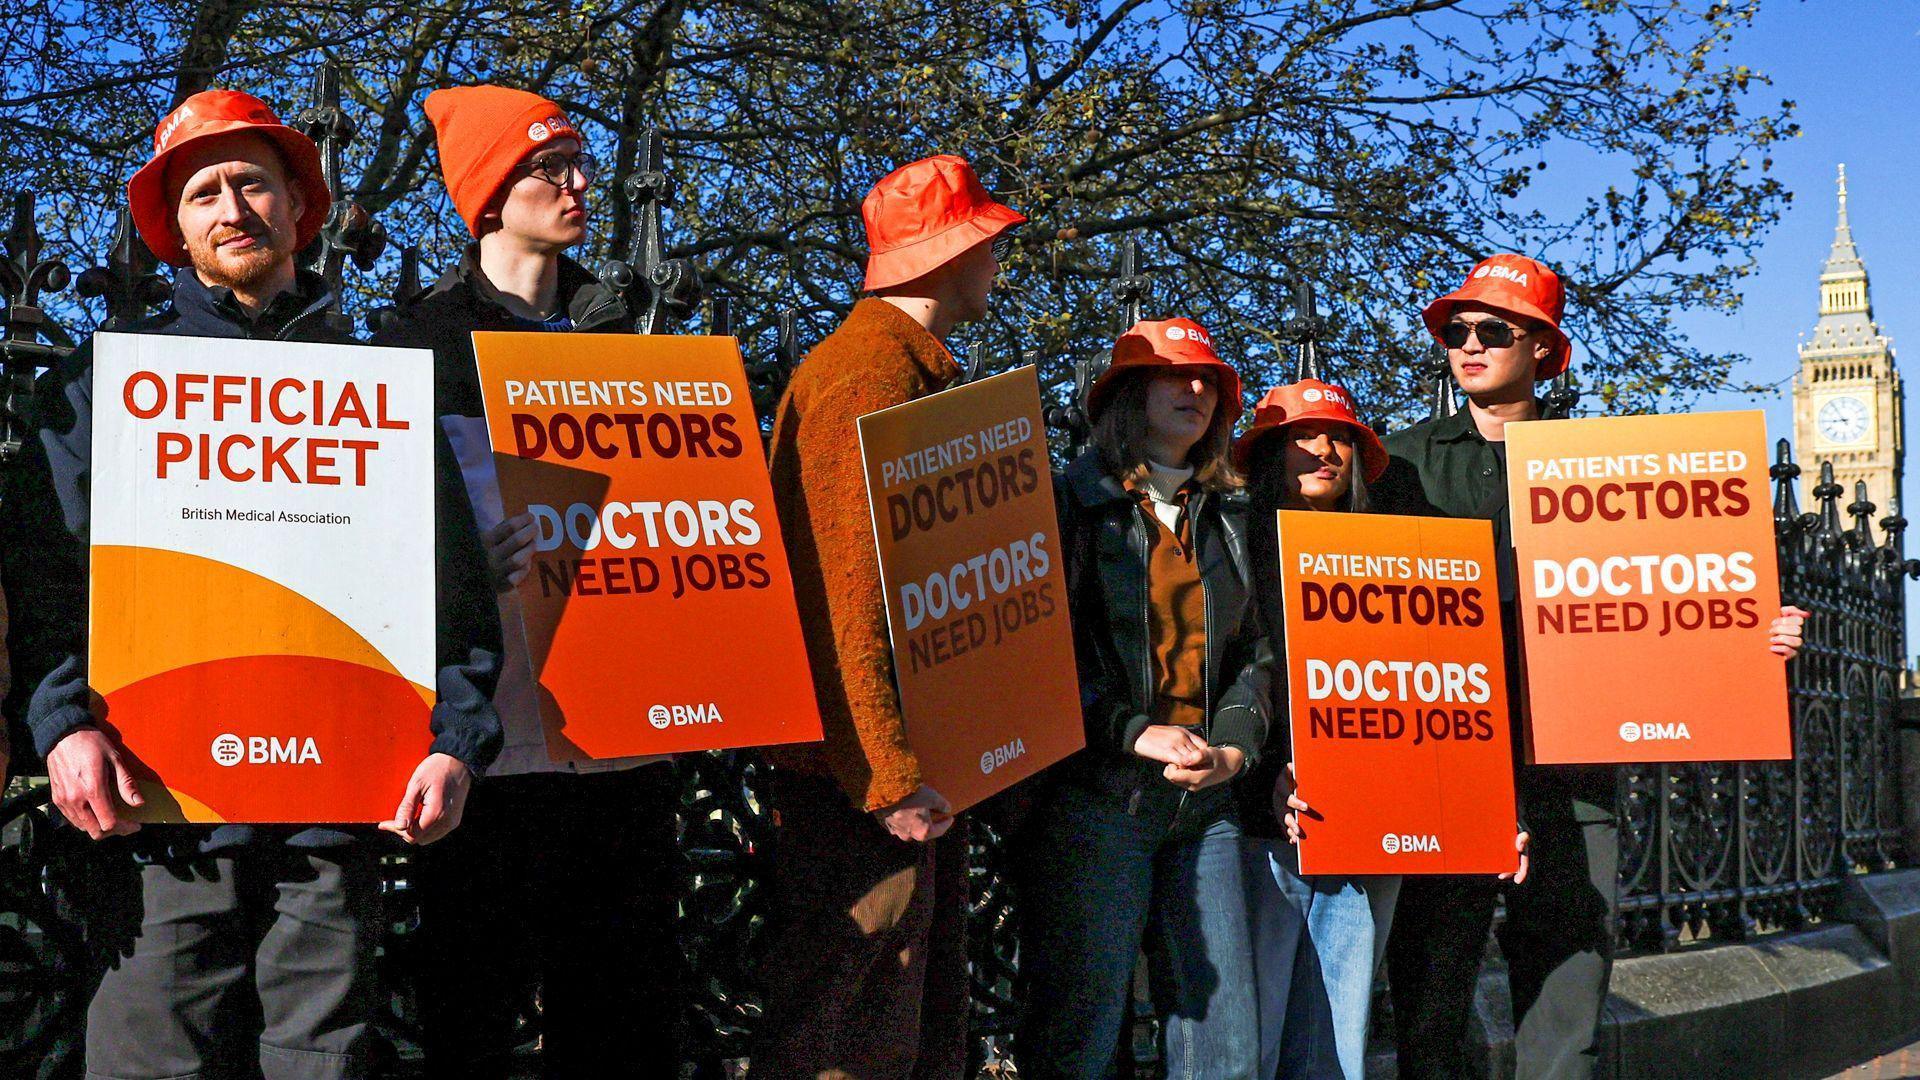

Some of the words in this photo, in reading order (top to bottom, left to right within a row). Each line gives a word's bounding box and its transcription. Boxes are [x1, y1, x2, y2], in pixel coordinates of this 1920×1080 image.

[160, 106, 193, 149] BMA
[1489, 265, 1528, 287] BMA
[123, 370, 410, 430] OFFICIAL
[505, 380, 648, 406] PATIENTS
[653, 381, 732, 406] NEED
[511, 412, 743, 460] DOCTORS
[881, 434, 977, 488] PATIENTS
[980, 416, 1031, 455] NEED
[156, 432, 379, 487] PICKET
[1526, 453, 1661, 481] PATIENTS
[1667, 450, 1747, 474] NEED
[181, 507, 222, 521] British
[225, 509, 275, 522] Medical
[278, 510, 351, 525] Association
[887, 448, 1038, 543] DOCTORS
[1529, 477, 1750, 525] DOCTORS
[527, 499, 762, 552] DOCTORS
[538, 556, 660, 598] NEED
[671, 552, 771, 599] JOBS
[901, 532, 1050, 631] DOCTORS
[1299, 552, 1412, 579] PATIENTS
[1417, 557, 1481, 581] NEED
[1533, 551, 1757, 599] DOCTORS
[1301, 581, 1484, 628] DOCTORS
[1537, 601, 1649, 635] NEED
[1659, 597, 1760, 637] JOBS
[908, 612, 987, 674] NEED
[993, 582, 1056, 648] JOBS
[1306, 658, 1491, 704] DOCTORS
[671, 703, 724, 726] BMA
[1309, 706, 1405, 740] NEED
[1413, 708, 1494, 746] JOBS
[1642, 722, 1692, 741] BMA
[248, 736, 322, 764] BMA
[994, 738, 1026, 767] BMA
[1401, 834, 1442, 852] BMA
